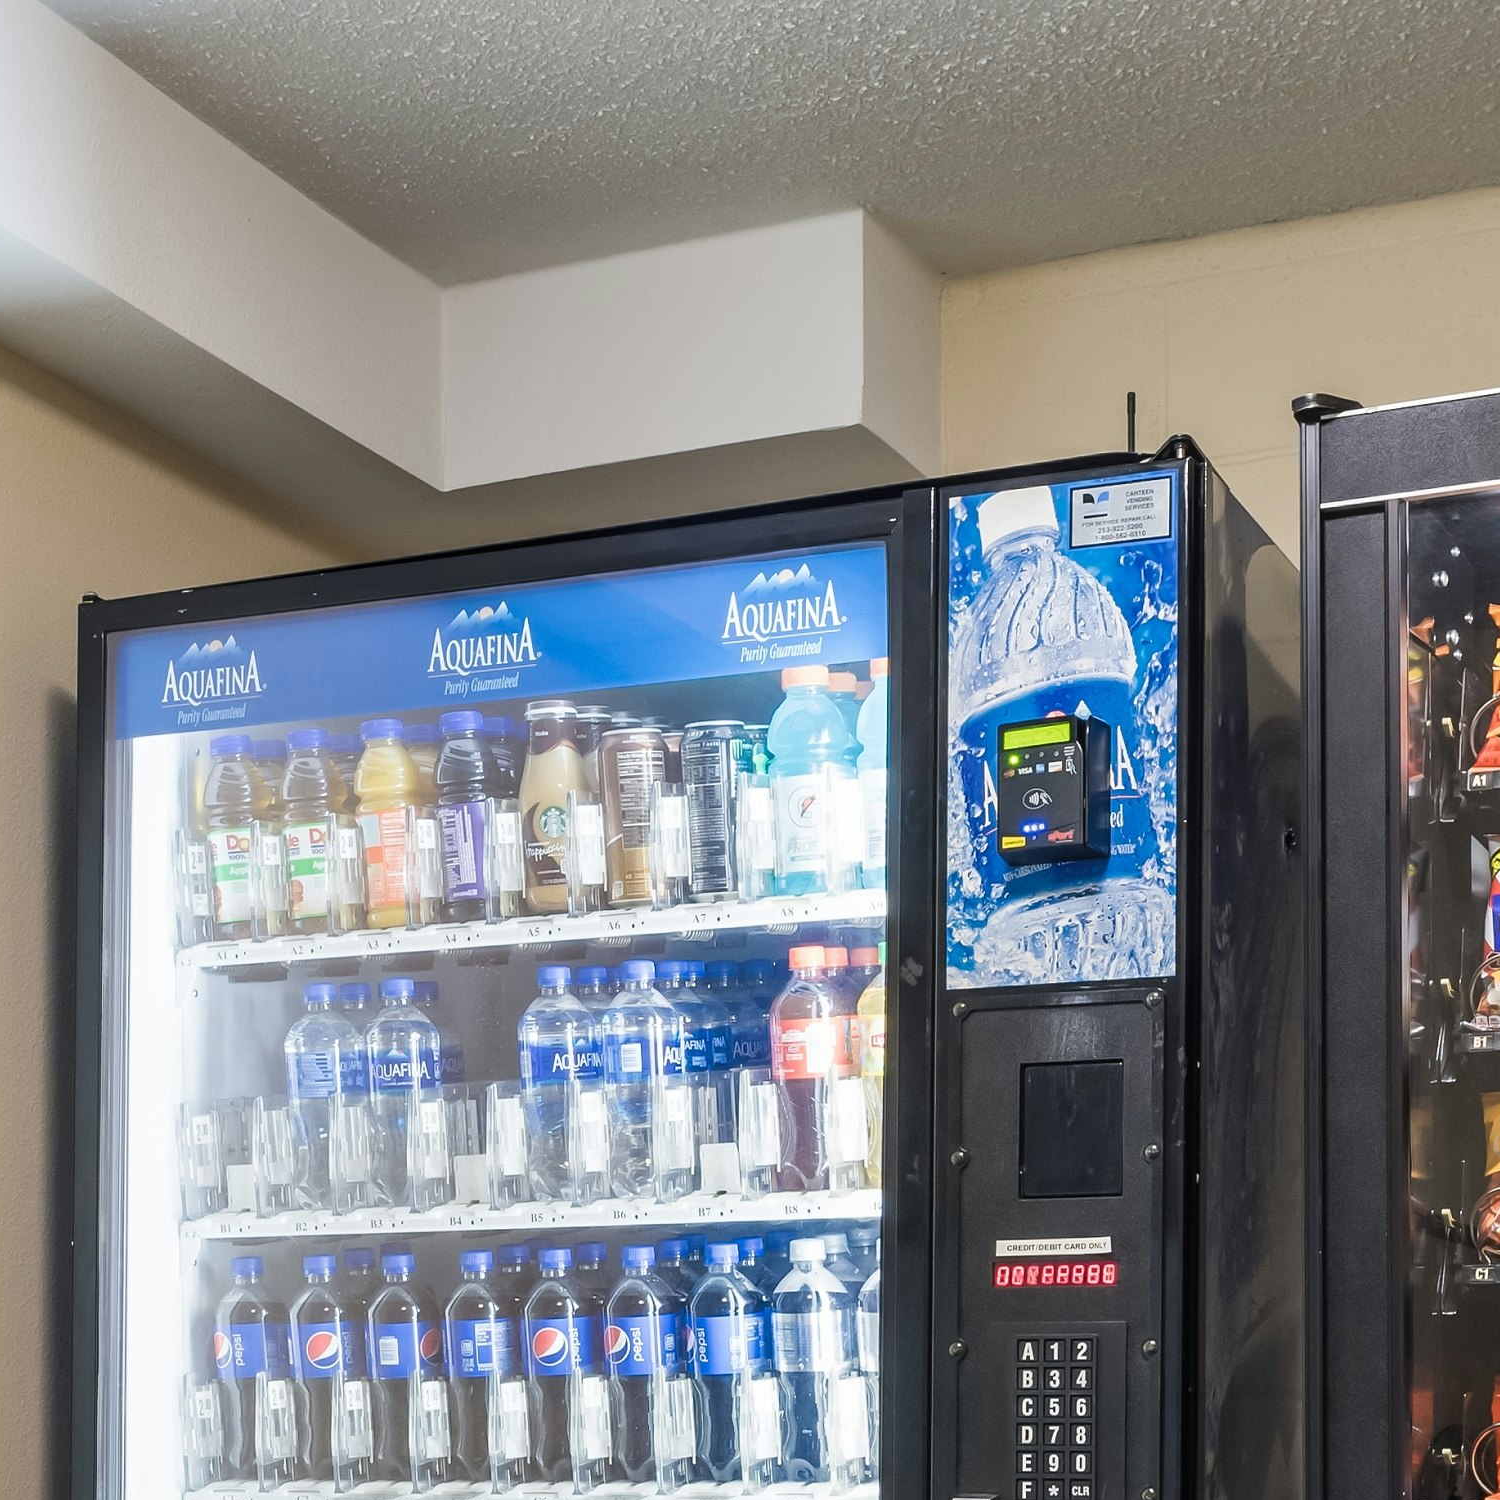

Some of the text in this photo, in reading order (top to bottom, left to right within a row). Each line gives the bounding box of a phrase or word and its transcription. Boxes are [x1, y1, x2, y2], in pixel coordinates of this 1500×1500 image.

[1126, 489, 1154, 497] CANTEEN
[1125, 503, 1154, 511] SERVICES
[722, 580, 841, 642] AQUAFINA
[427, 617, 537, 676] AQUAFINA
[740, 637, 822, 664] Purity Guaranteed
[162, 650, 263, 707] AQUAFINA
[444, 673, 519, 698] Purity Guaranteed
[177, 703, 246, 726] Purity Guaranteed
[607, 921, 620, 930] A6
[692, 914, 706, 923] A7
[527, 928, 540, 937] A5
[531, 1214, 543, 1223] B5
[613, 1210, 626, 1219] B6
[698, 1208, 711, 1216] B7
[1007, 1244, 1062, 1252] CREDIT/DEBIT
[1064, 1242, 1087, 1250] CARD
[232, 1333, 245, 1366] pepsi
[630, 1328, 645, 1362] pepsi
[697, 1328, 709, 1362] pepsi
[1022, 1342, 1087, 1360] A 1 2
[1022, 1370, 1087, 1388] B 3 4
[1022, 1398, 1086, 1416] C 5 6
[1021, 1426, 1086, 1444] D 7 8
[1022, 1454, 1086, 1472] E 9 0
[1022, 1482, 1090, 1499] F CLR
